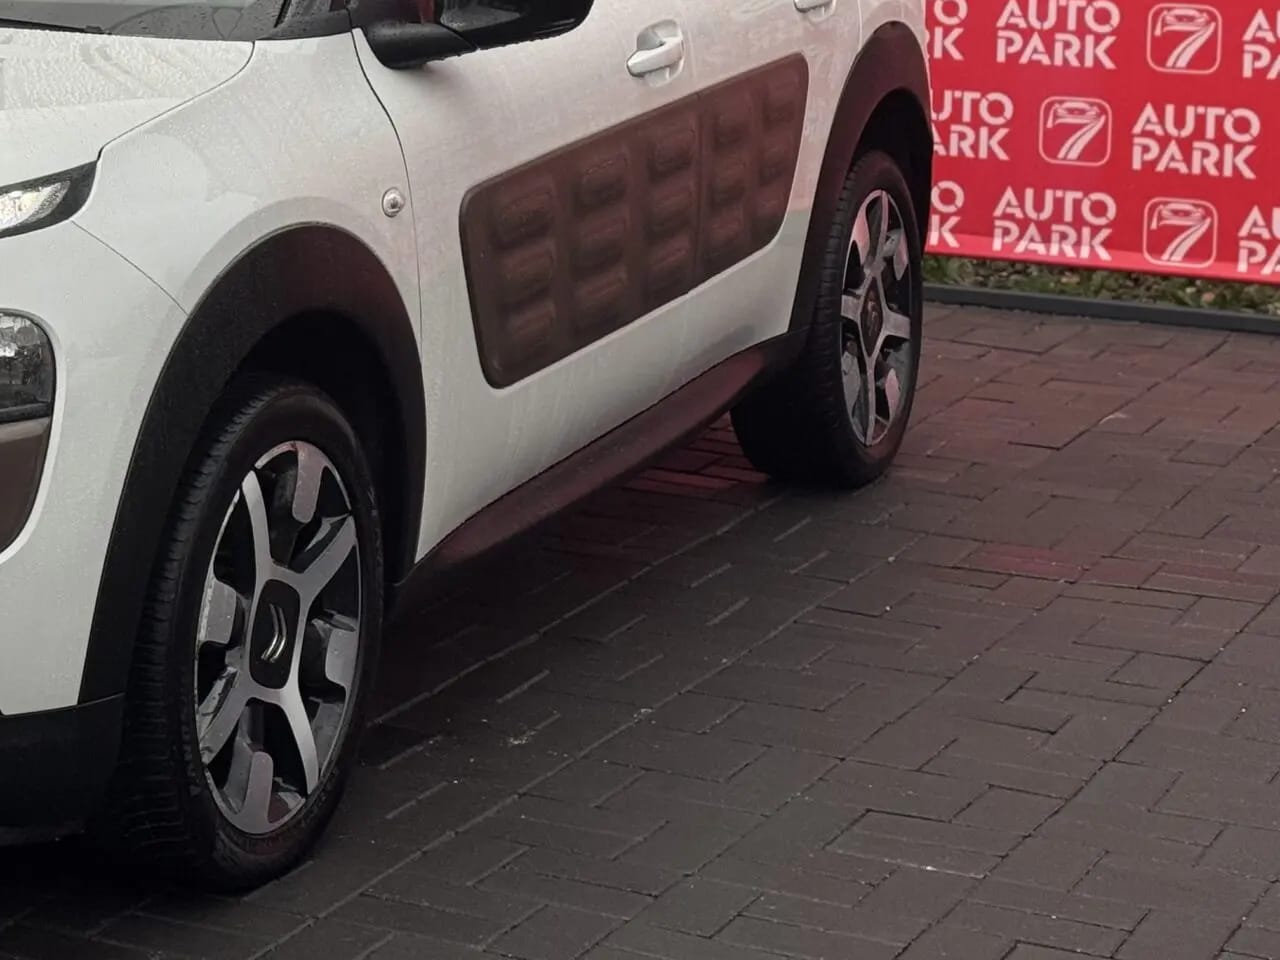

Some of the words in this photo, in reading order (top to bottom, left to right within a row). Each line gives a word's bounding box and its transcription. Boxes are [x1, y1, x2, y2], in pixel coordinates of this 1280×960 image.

[996, 30, 1117, 70] PARK
[1132, 103, 1261, 142] AUTO
[1132, 138, 1256, 180] PARK
[993, 186, 1117, 225] AUTO
[992, 222, 1112, 261] PARK
